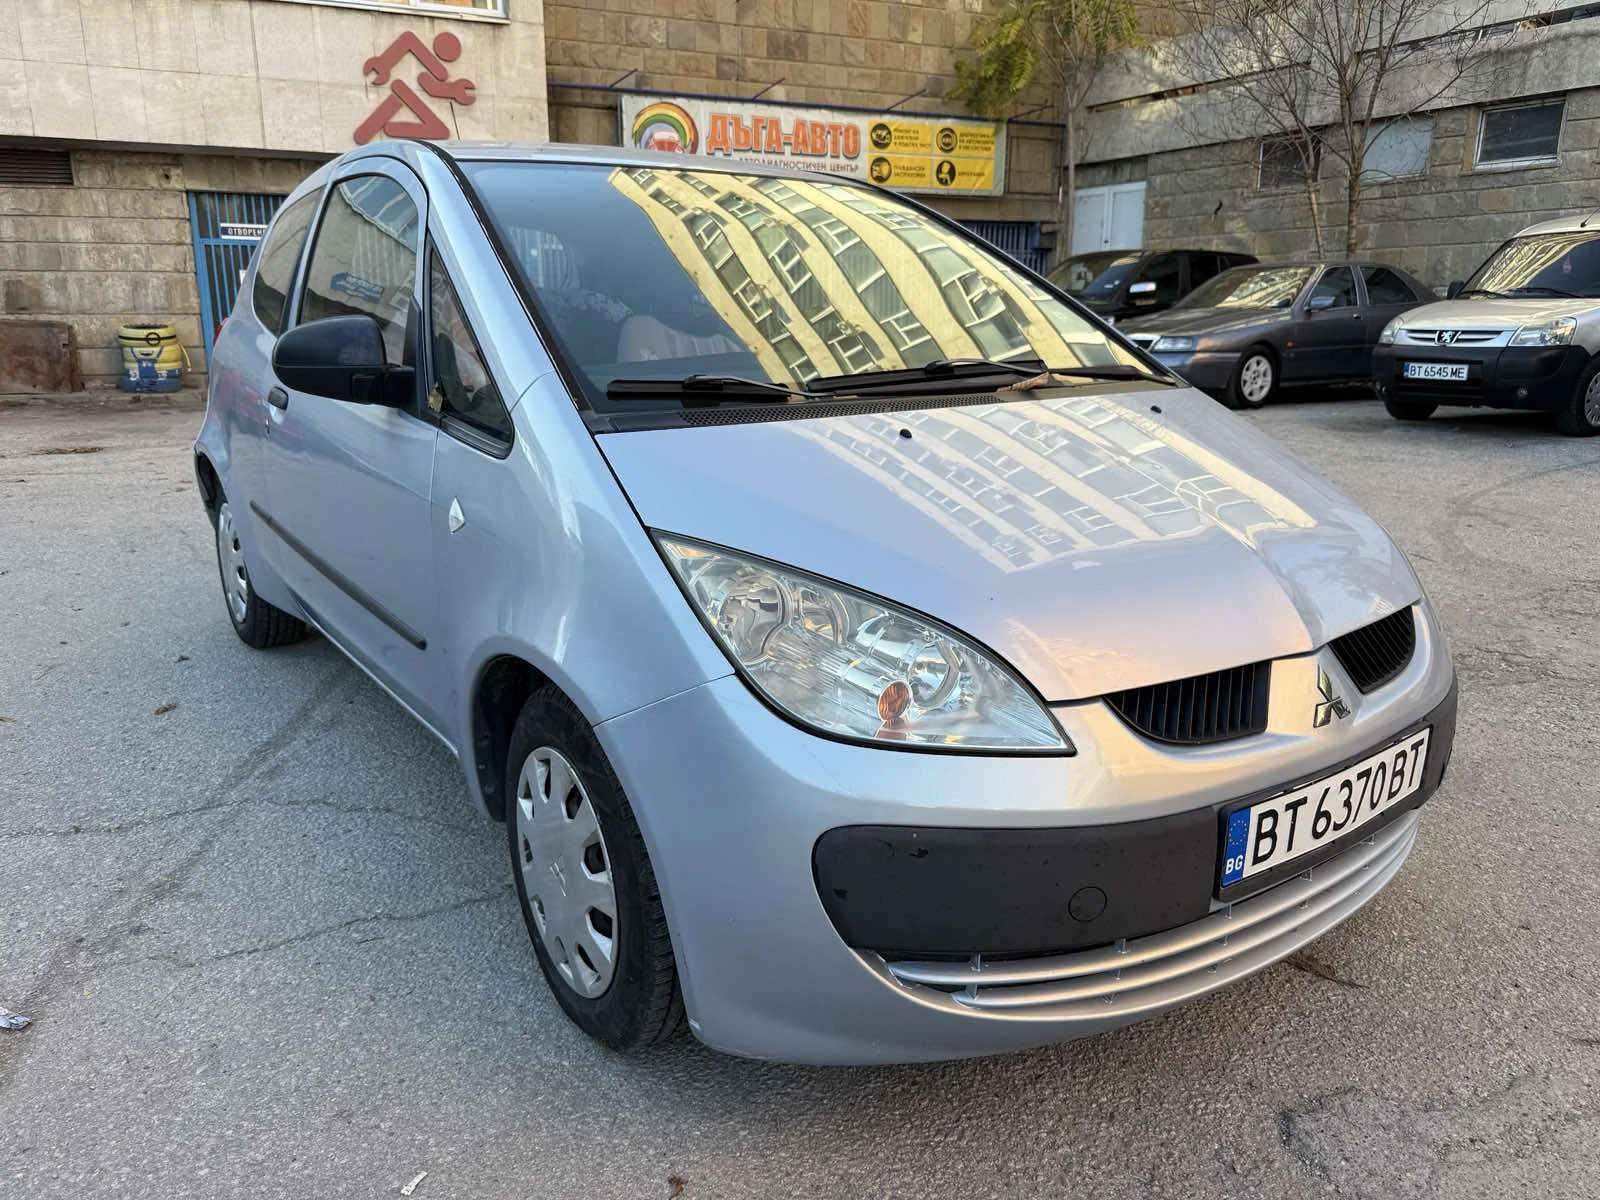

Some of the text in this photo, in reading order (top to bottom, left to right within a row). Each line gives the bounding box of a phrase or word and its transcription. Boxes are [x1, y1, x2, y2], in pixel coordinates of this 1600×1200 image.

[706, 113, 861, 159] ДЪГА-АВТО
[740, 158, 859, 173] ОДИАГНОСТИЧЕН ЦЕНТЪР
[1410, 365, 1423, 377] BT
[1424, 366, 1449, 378] 6545
[1450, 367, 1465, 379] ME
[1252, 737, 1425, 866] BT 6370 BT
[1225, 855, 1245, 875] BG
